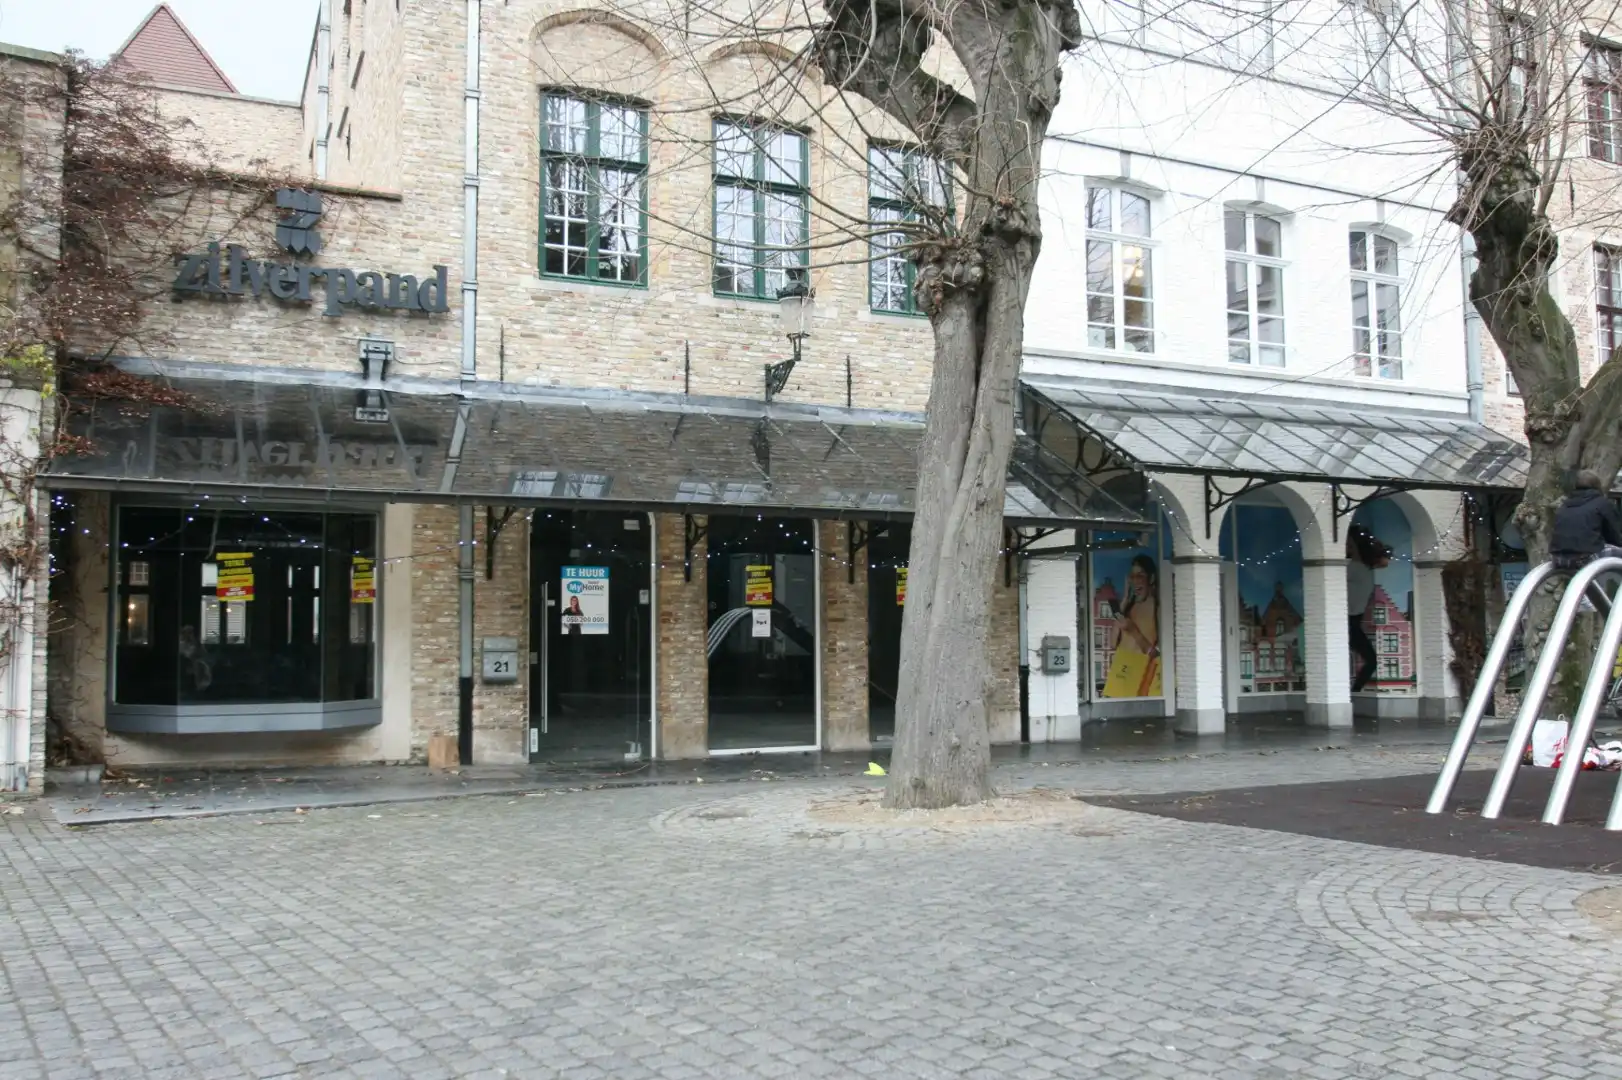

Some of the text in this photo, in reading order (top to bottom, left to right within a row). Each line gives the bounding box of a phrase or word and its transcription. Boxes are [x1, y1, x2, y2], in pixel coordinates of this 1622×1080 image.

[173, 242, 450, 317] zilverpand
[566, 568, 605, 577] TE HUUR
[1054, 656, 1064, 665] 23
[494, 661, 508, 672] 21
